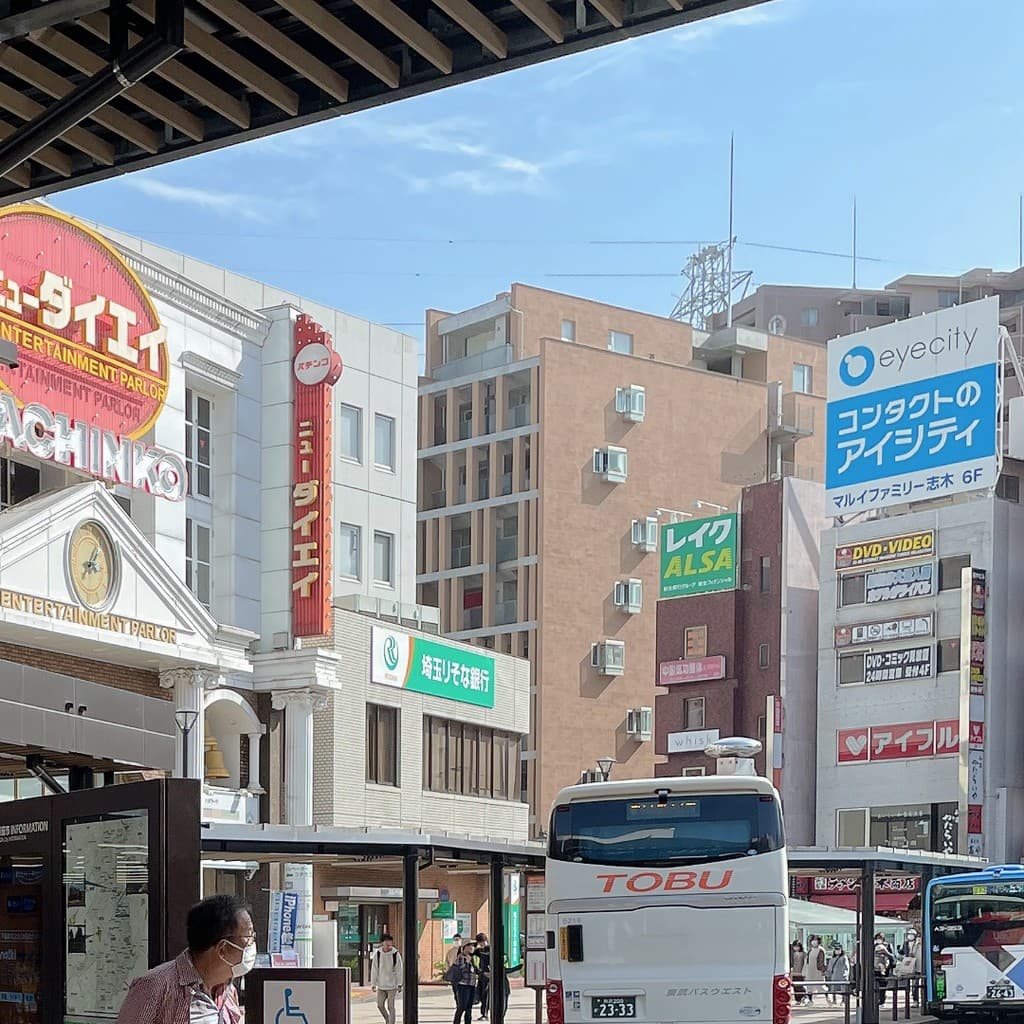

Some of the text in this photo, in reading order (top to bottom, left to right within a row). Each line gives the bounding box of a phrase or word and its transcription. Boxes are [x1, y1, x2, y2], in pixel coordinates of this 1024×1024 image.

[879, 326, 978, 372] eyecity
[120, 373, 166, 401] PARLOR
[838, 380, 982, 436] コンタクトの
[837, 416, 981, 475] アイシティ
[833, 467, 984, 508] マルイファミリー志木 6F
[292, 420, 319, 598] ニューダイエイ
[666, 518, 732, 553] レイク
[663, 547, 733, 579] ALSA
[0, 590, 177, 645] ENTERTAINMENT PARLOR
[421, 653, 490, 693] 埼玉りそな銀行
[873, 726, 960, 755] アイフル
[596, 870, 734, 893] TOBU
